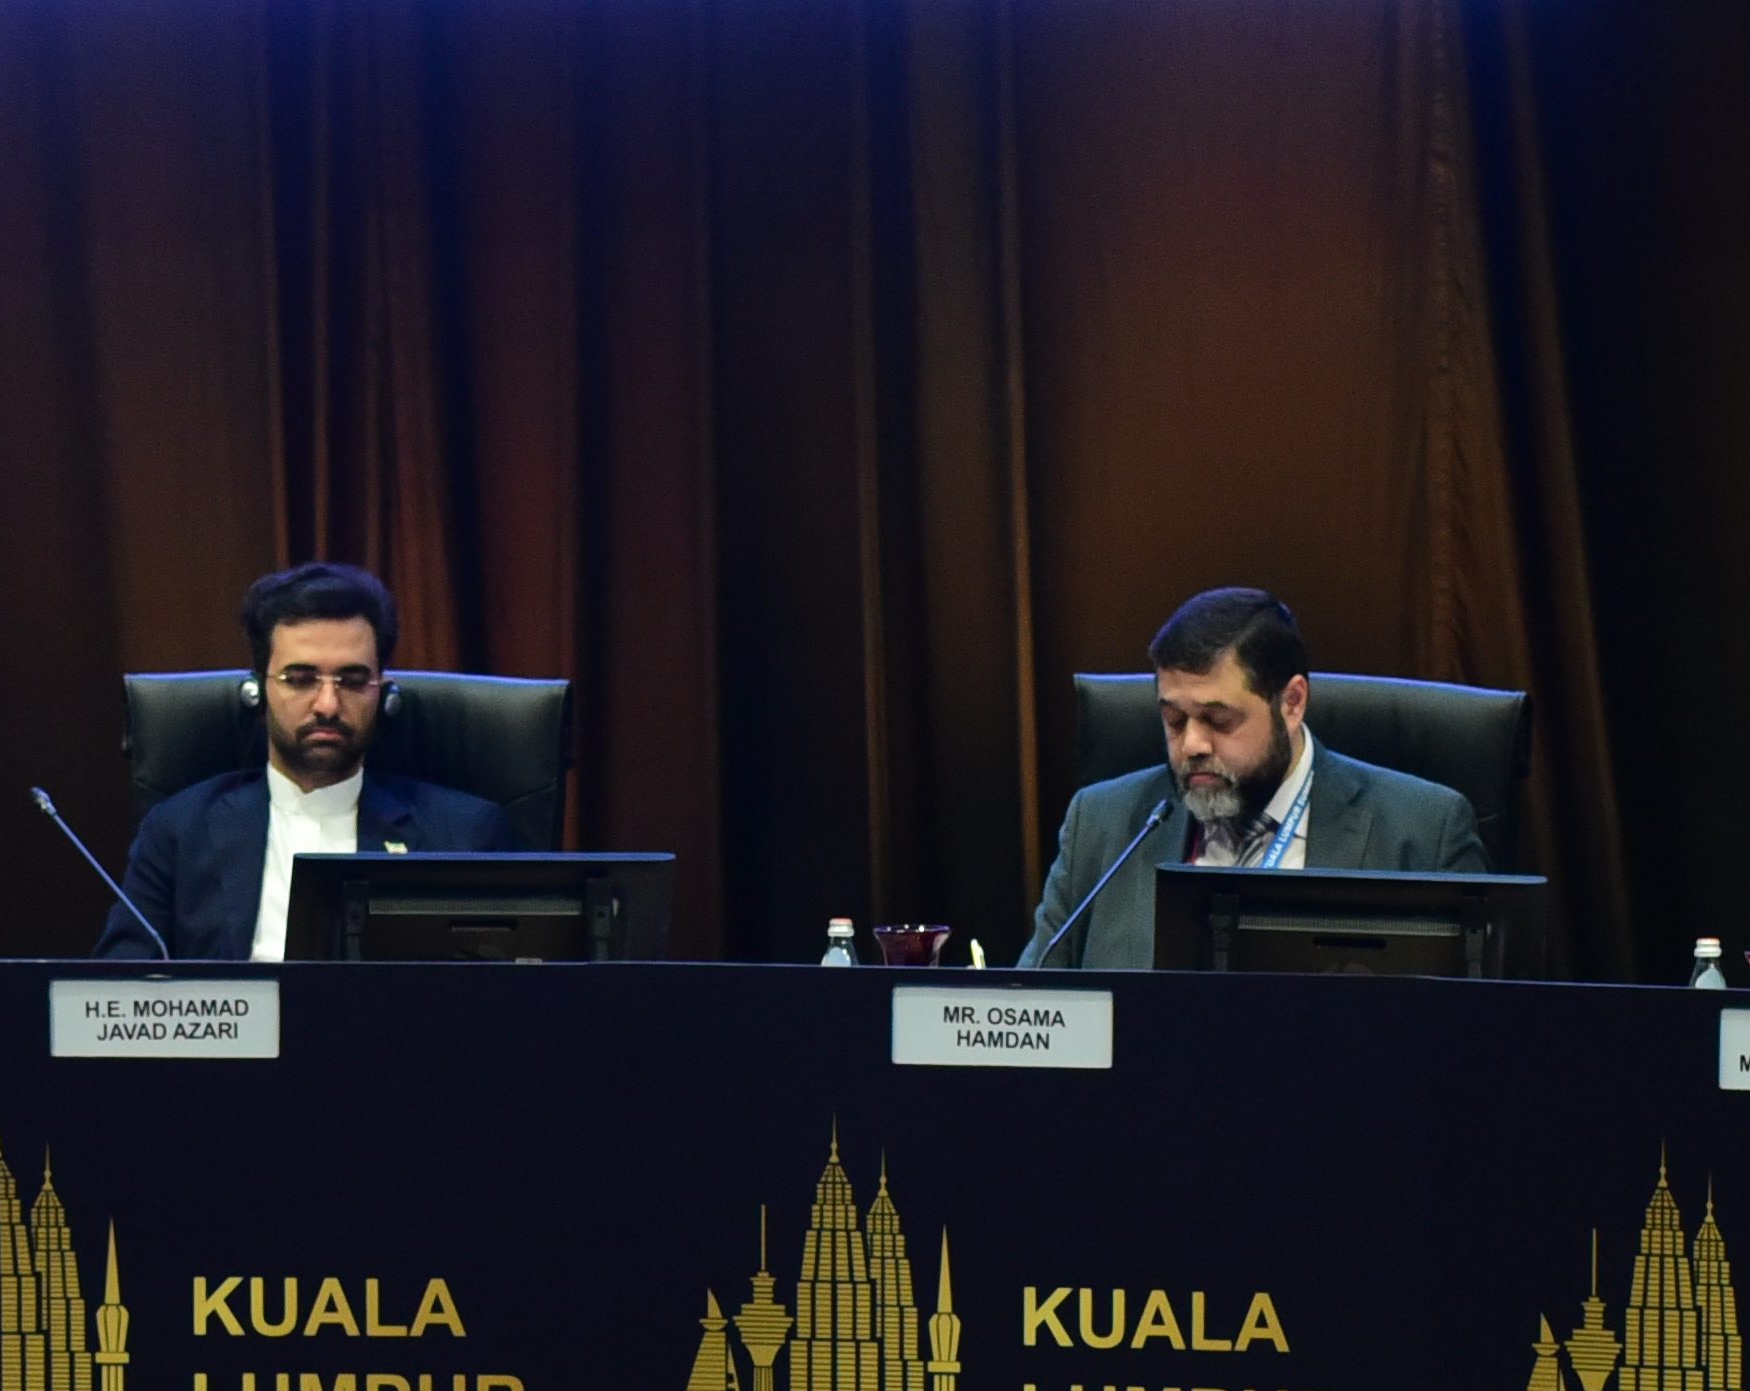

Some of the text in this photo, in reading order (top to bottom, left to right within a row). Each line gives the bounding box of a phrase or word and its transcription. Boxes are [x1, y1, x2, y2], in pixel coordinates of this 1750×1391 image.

[84, 999, 250, 1018] H.E. MOHAMAD
[942, 1005, 1066, 1028] MR. OSAMA
[96, 1022, 239, 1041] JAVAD AZARI
[956, 1029, 1051, 1051] HAMDAN
[191, 1277, 465, 1337] KUALA
[1022, 1287, 1288, 1352] KUALA
